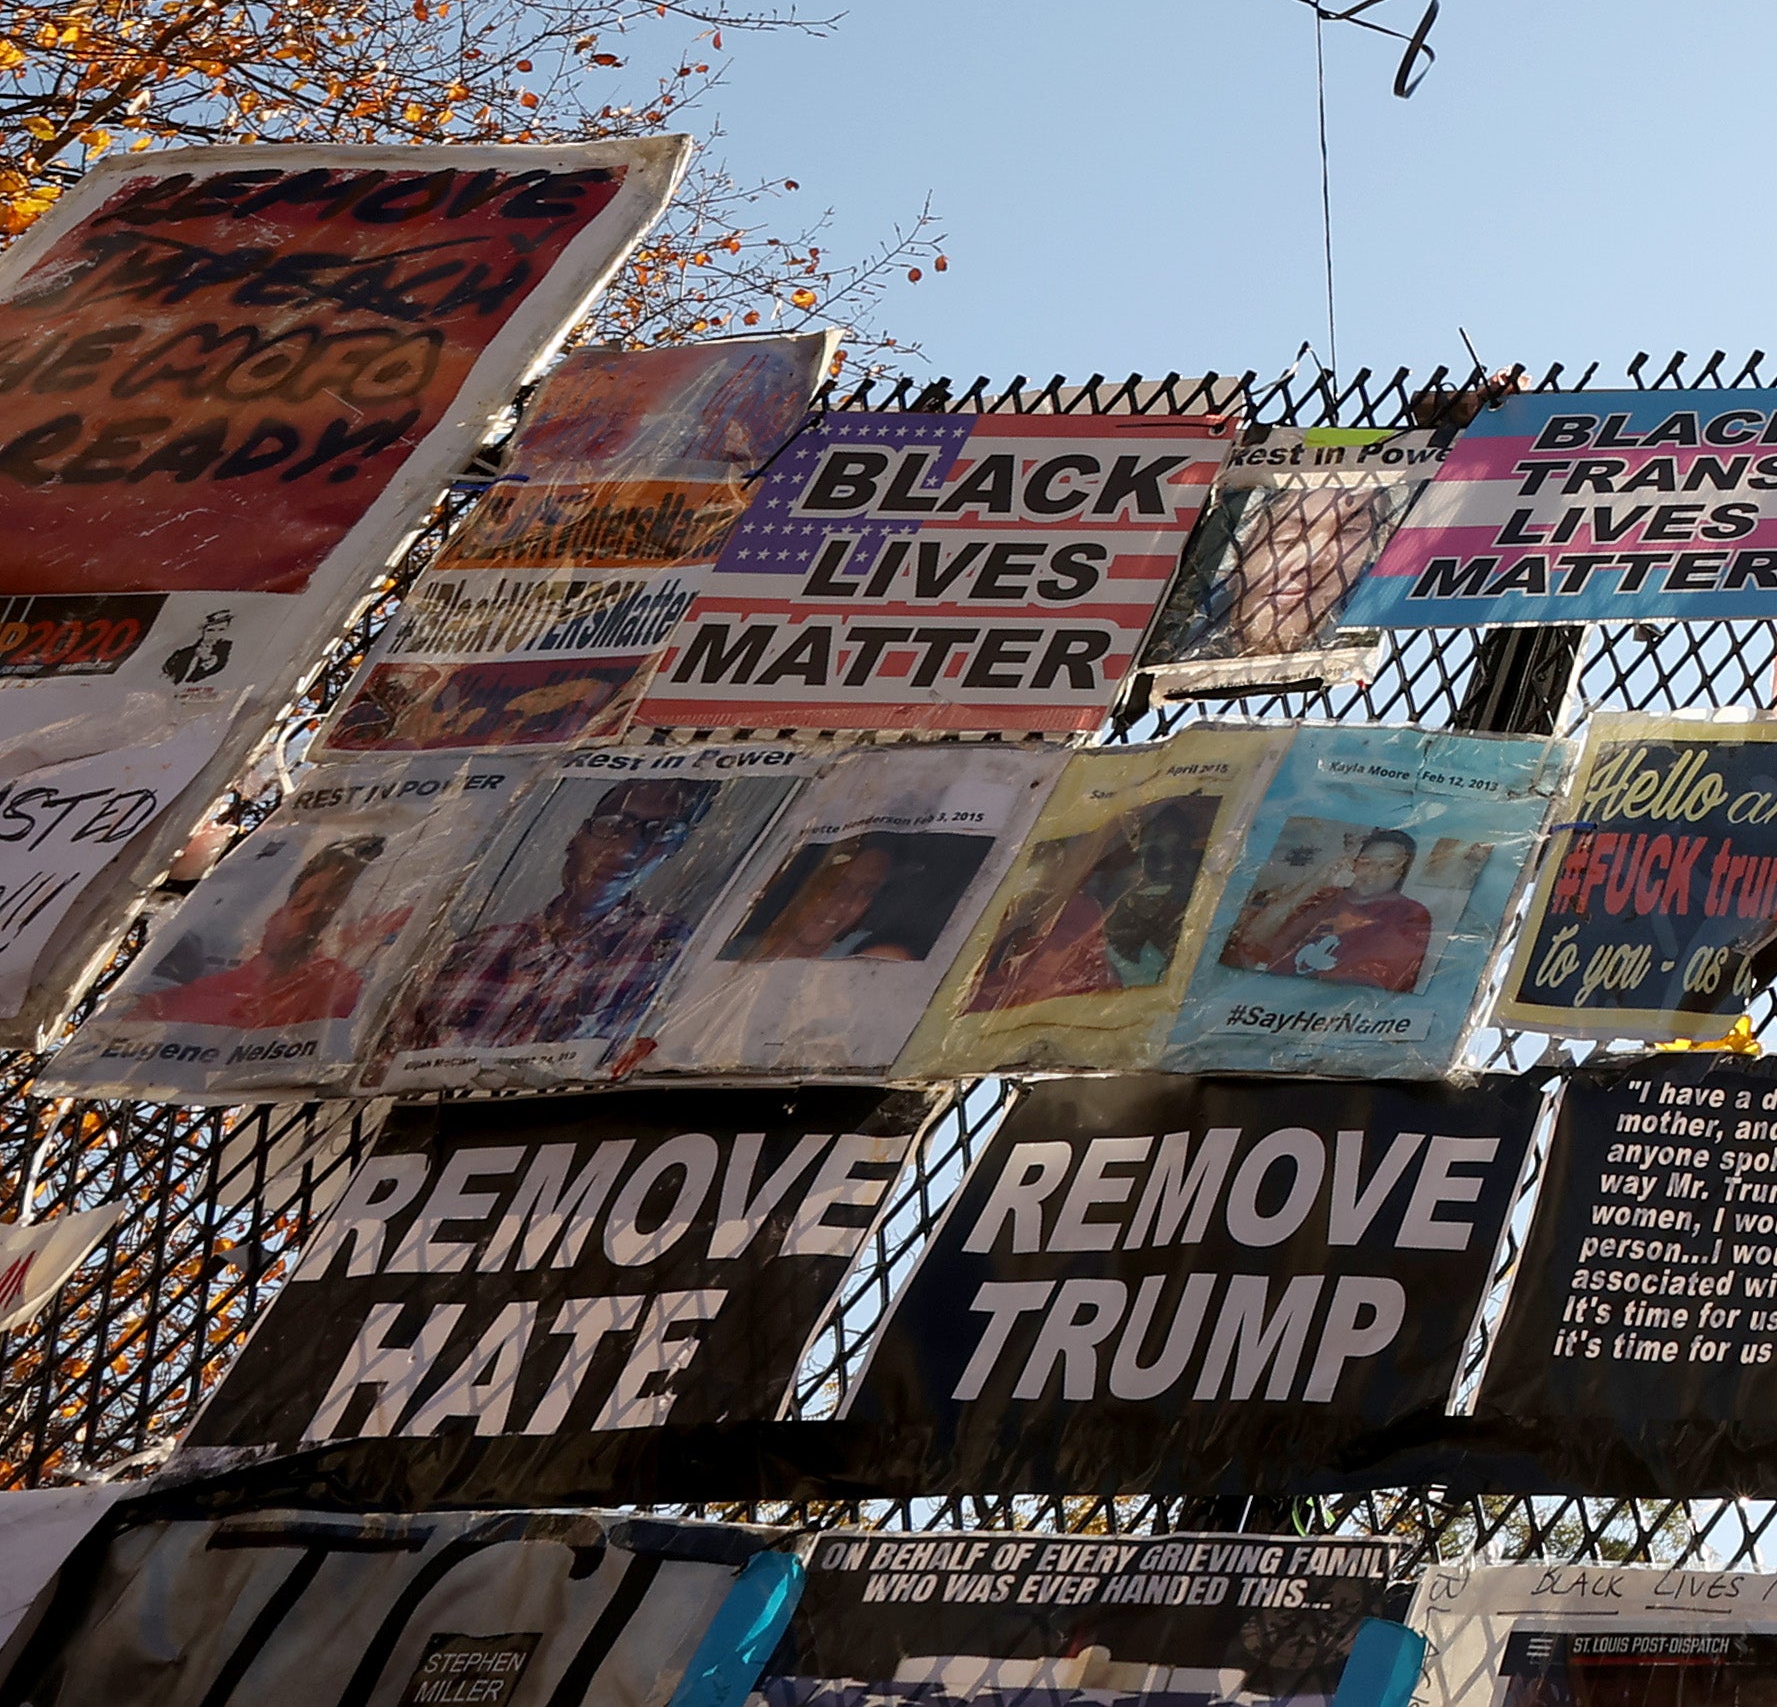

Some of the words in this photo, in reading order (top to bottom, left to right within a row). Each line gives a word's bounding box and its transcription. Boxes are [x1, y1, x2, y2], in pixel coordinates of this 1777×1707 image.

[802, 452, 1190, 514] BLACK
[1492, 503, 1760, 547] LIVES
[808, 542, 1107, 601] LIVES
[671, 624, 1112, 689] MATTER
[1369, 765, 1410, 780] Moore
[1423, 770, 1445, 783] Feb
[1448, 775, 1465, 789] 12,
[1582, 747, 1728, 823] Hello
[952, 812, 984, 822] 2015
[1551, 833, 1705, 917] #FUCK
[1536, 924, 1579, 989] to
[1574, 943, 1653, 1006] you
[1683, 946, 1730, 994] as
[1227, 1004, 1411, 1034] #SayHerName
[228, 1038, 317, 1066] Nelson
[1659, 1083, 1725, 1108] have
[1616, 1110, 1724, 1144] mother,
[1607, 1143, 1710, 1171] anyone
[961, 1127, 1500, 1254] REMOVE
[1600, 1173, 1658, 1202] way
[1666, 1172, 1709, 1200] Mr.
[293, 1132, 912, 1282] REMOVE
[1592, 1205, 1701, 1238] women,
[951, 1273, 1406, 1404] TRUMP
[1553, 1329, 1602, 1359] it's
[1612, 1332, 1679, 1362] time
[1688, 1335, 1732, 1362] for
[301, 1289, 728, 1442] HATE
[821, 1542, 870, 1571] ON
[869, 1543, 990, 1571] BEHALF
[991, 1543, 1038, 1571] OF
[1036, 1544, 1141, 1574] EVERY
[1139, 1543, 1284, 1575] GRIEVING
[862, 1573, 939, 1603] WHO
[942, 1574, 1016, 1603] WAS
[1016, 1575, 1100, 1604] EVER
[1102, 1575, 1230, 1606] HANDED
[1237, 1577, 1331, 1610] THIS...
[1530, 1567, 1625, 1598] BLACK
[1653, 1568, 1746, 1599] LIVES
[1573, 1639, 1594, 1654] ST.
[1593, 1638, 1630, 1654] LOUIS
[1631, 1637, 1730, 1654] POST-DISPATCH
[423, 1651, 528, 1675] STEPHEN
[412, 1679, 505, 1704] MILLER
